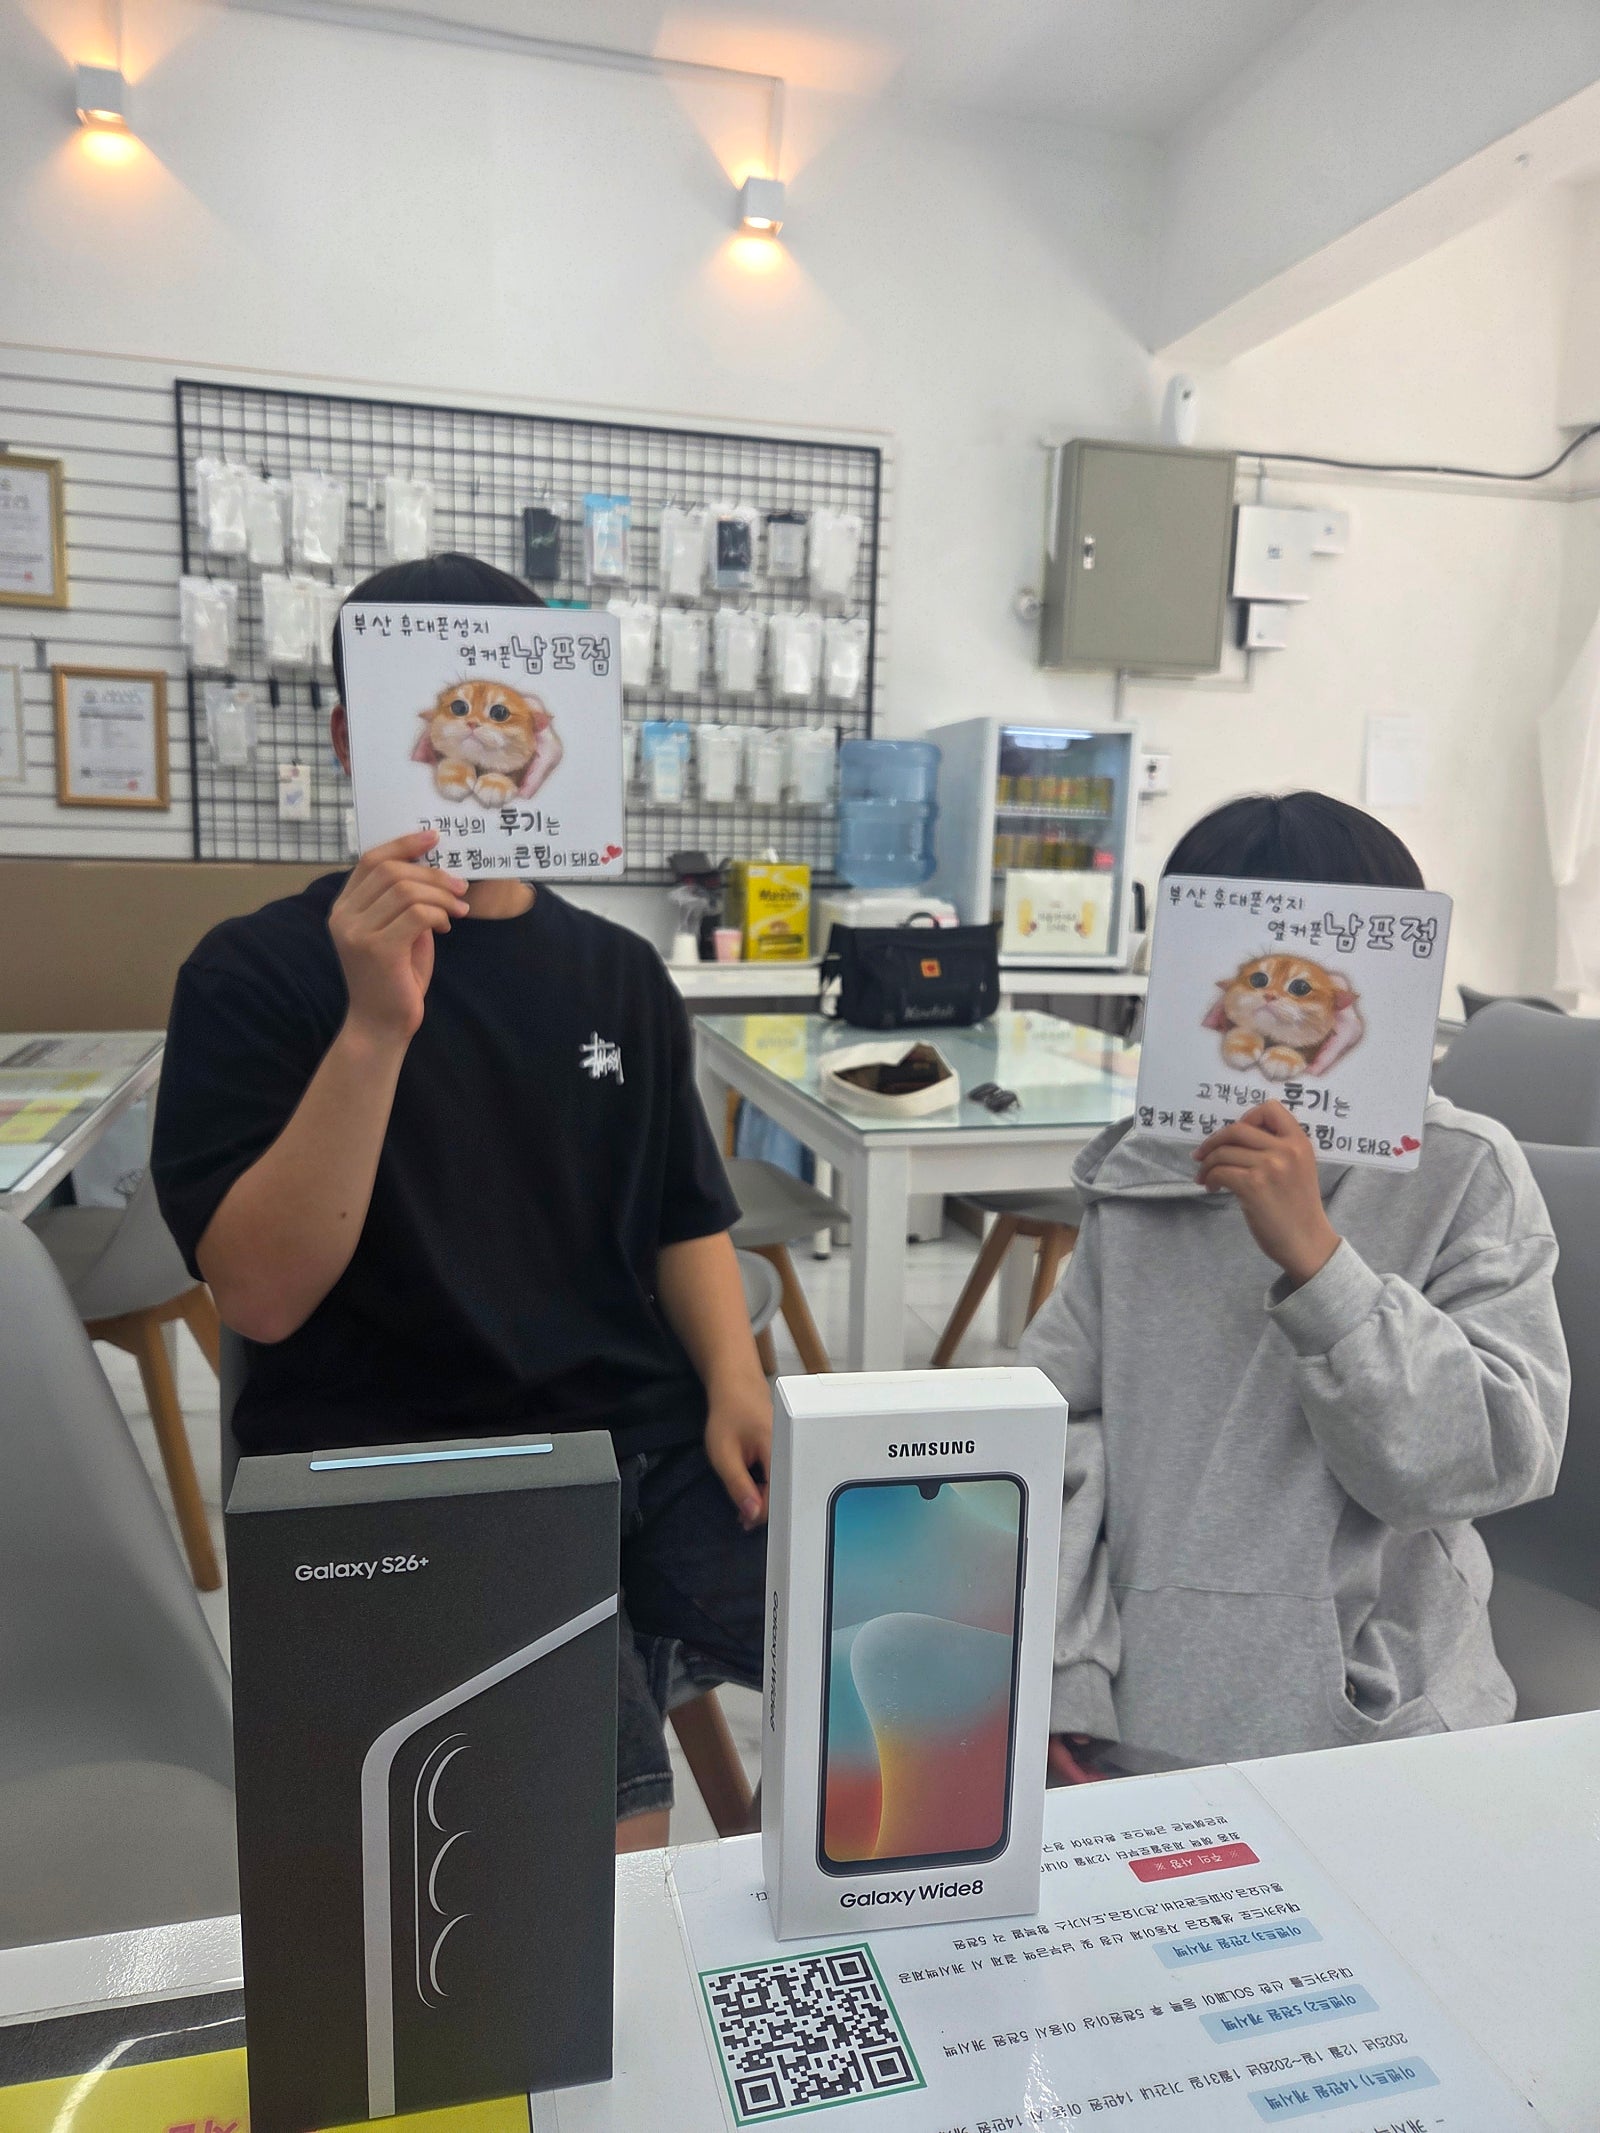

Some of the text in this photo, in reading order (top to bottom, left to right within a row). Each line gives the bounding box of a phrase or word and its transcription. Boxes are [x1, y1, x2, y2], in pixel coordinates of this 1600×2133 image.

[354, 613, 489, 641] 부산 휴대폰성지
[419, 808, 561, 837] 고객님의 후기는
[1170, 886, 1303, 915] 부산 휴대폰성지
[1196, 1083, 1351, 1118] 고객님의 후기는
[887, 1440, 976, 1458] SAMSUNG
[294, 1554, 430, 1582] Galaxy S26+
[1040, 1860, 1068, 1872] 이내
[839, 1879, 984, 1908] Galaxy Wide8
[1238, 1902, 1300, 1920] 대상카드로
[1098, 1933, 1123, 1946] 신청
[1128, 1923, 1180, 1940] 자동이체
[1171, 1925, 1301, 1957] 이벤트3) 2만원 캐시백
[970, 1959, 982, 1970] 시
[989, 1953, 1017, 1966] 결제
[897, 1963, 965, 1984] 캐시백제공
[942, 1967, 1353, 2057] 대상카드를 신한 SOL페이 등록 후 5천원이상 이용시 5천원 캐시백
[1220, 1993, 1356, 2031] 이벤트2) 5천원 캐시백
[1327, 2043, 1357, 2059] 12월
[1361, 2032, 1408, 2051] 2025년
[1245, 2050, 1323, 2076] 1일~2026년
[1187, 2068, 1240, 2089] 1월31일
[1263, 2066, 1415, 2110] 이벤트1) 14만원 캐시백
[1087, 2091, 1133, 2111] 14만원
[1138, 2081, 1184, 2100] 기간내
[974, 2114, 1022, 2133] 14만원
